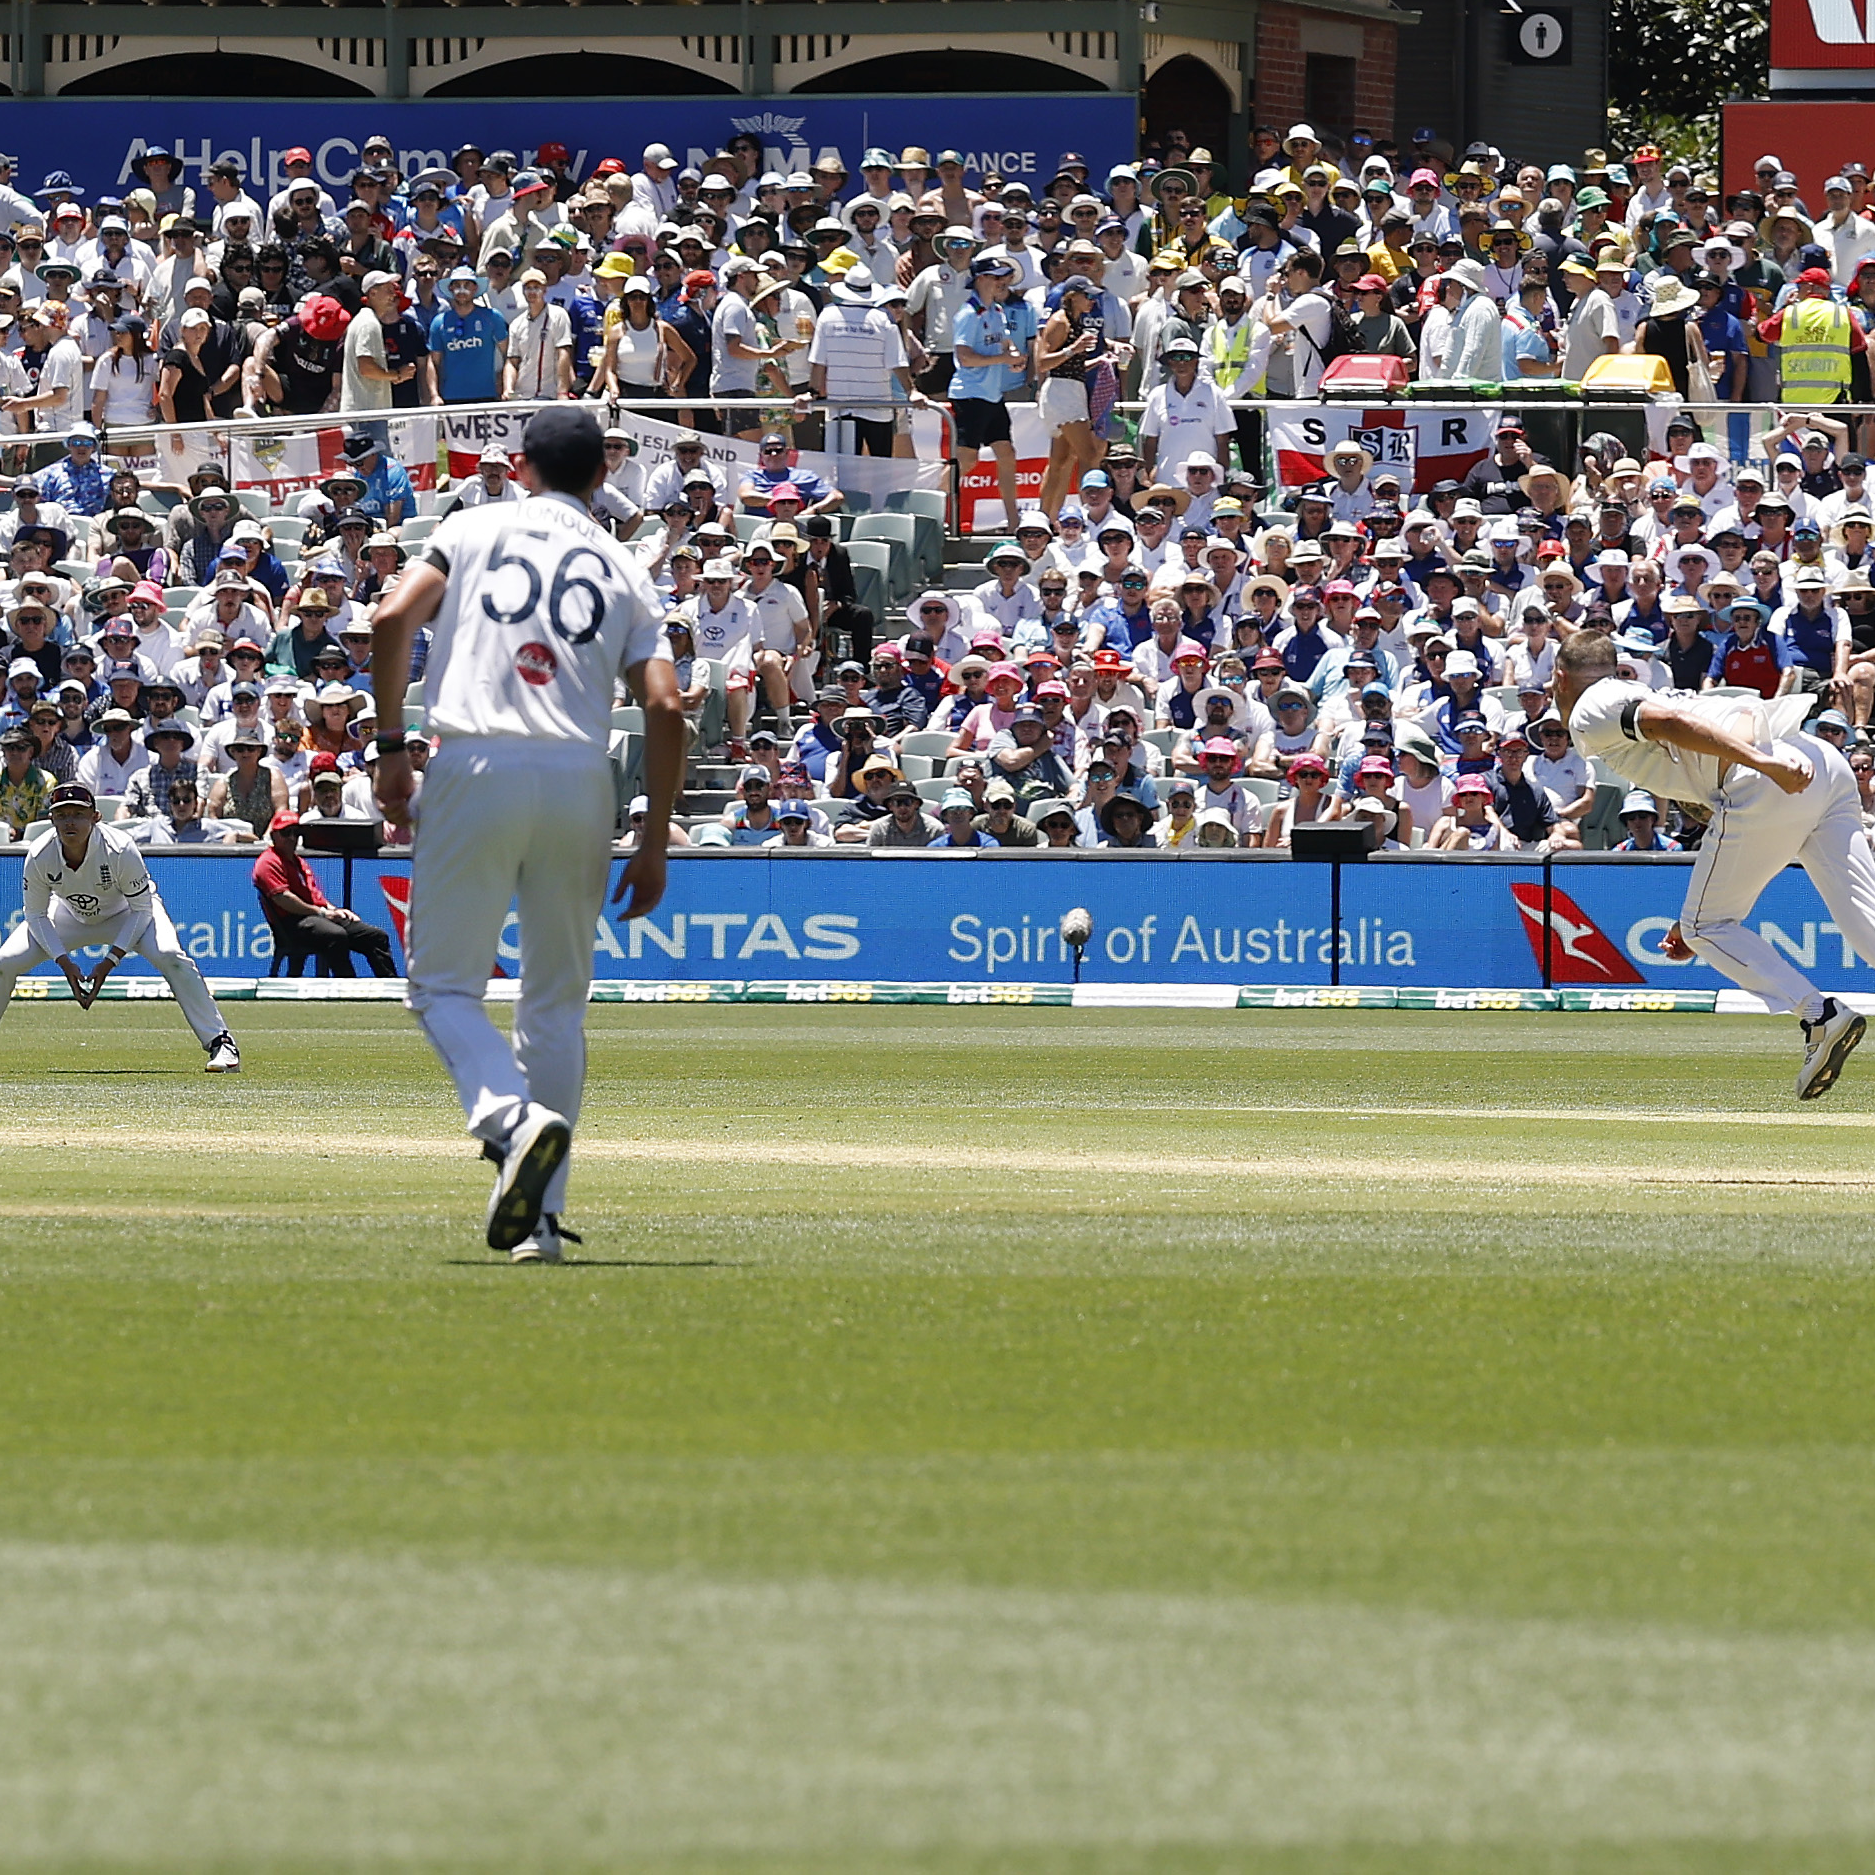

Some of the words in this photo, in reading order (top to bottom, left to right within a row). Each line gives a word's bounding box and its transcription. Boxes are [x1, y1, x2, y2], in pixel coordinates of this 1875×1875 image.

[446, 336, 483, 352] cinch
[1302, 417, 1326, 446] S
[1440, 417, 1468, 447] R
[481, 526, 613, 646] 56
[1104, 913, 1158, 964] of
[1170, 913, 1416, 967] Australia
[785, 982, 874, 1002] bet365
[946, 983, 1035, 1004] bet365
[1274, 988, 1360, 1008] bet365
[1434, 990, 1522, 1010] bet365
[1589, 993, 1676, 1012] bet365
